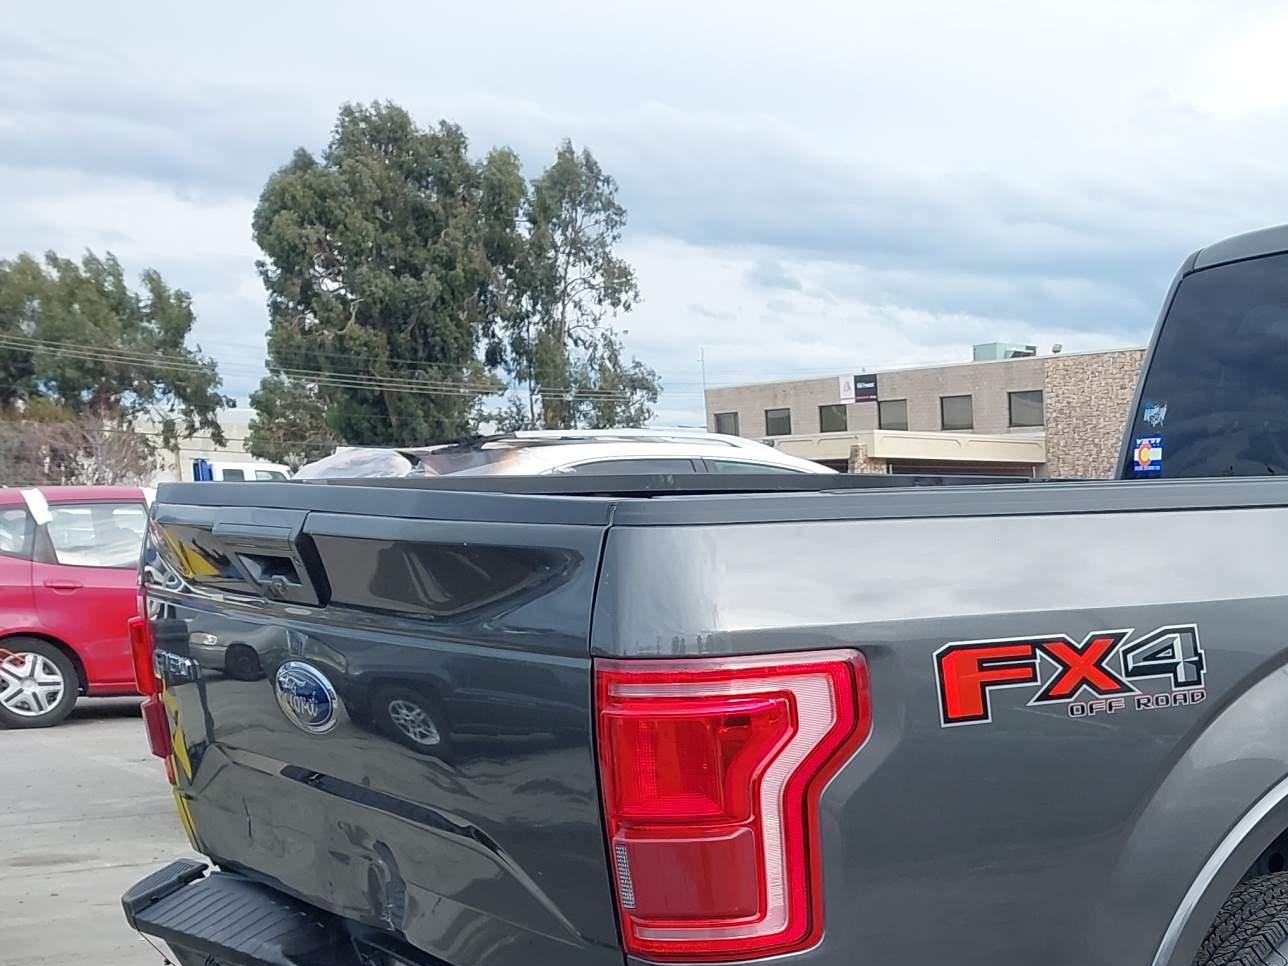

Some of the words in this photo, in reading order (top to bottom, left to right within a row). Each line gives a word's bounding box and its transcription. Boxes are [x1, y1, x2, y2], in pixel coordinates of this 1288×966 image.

[278, 674, 319, 718] Ford
[932, 623, 1207, 728] FX4
[1068, 698, 1125, 718] OFF
[1135, 688, 1207, 711] ROAD
